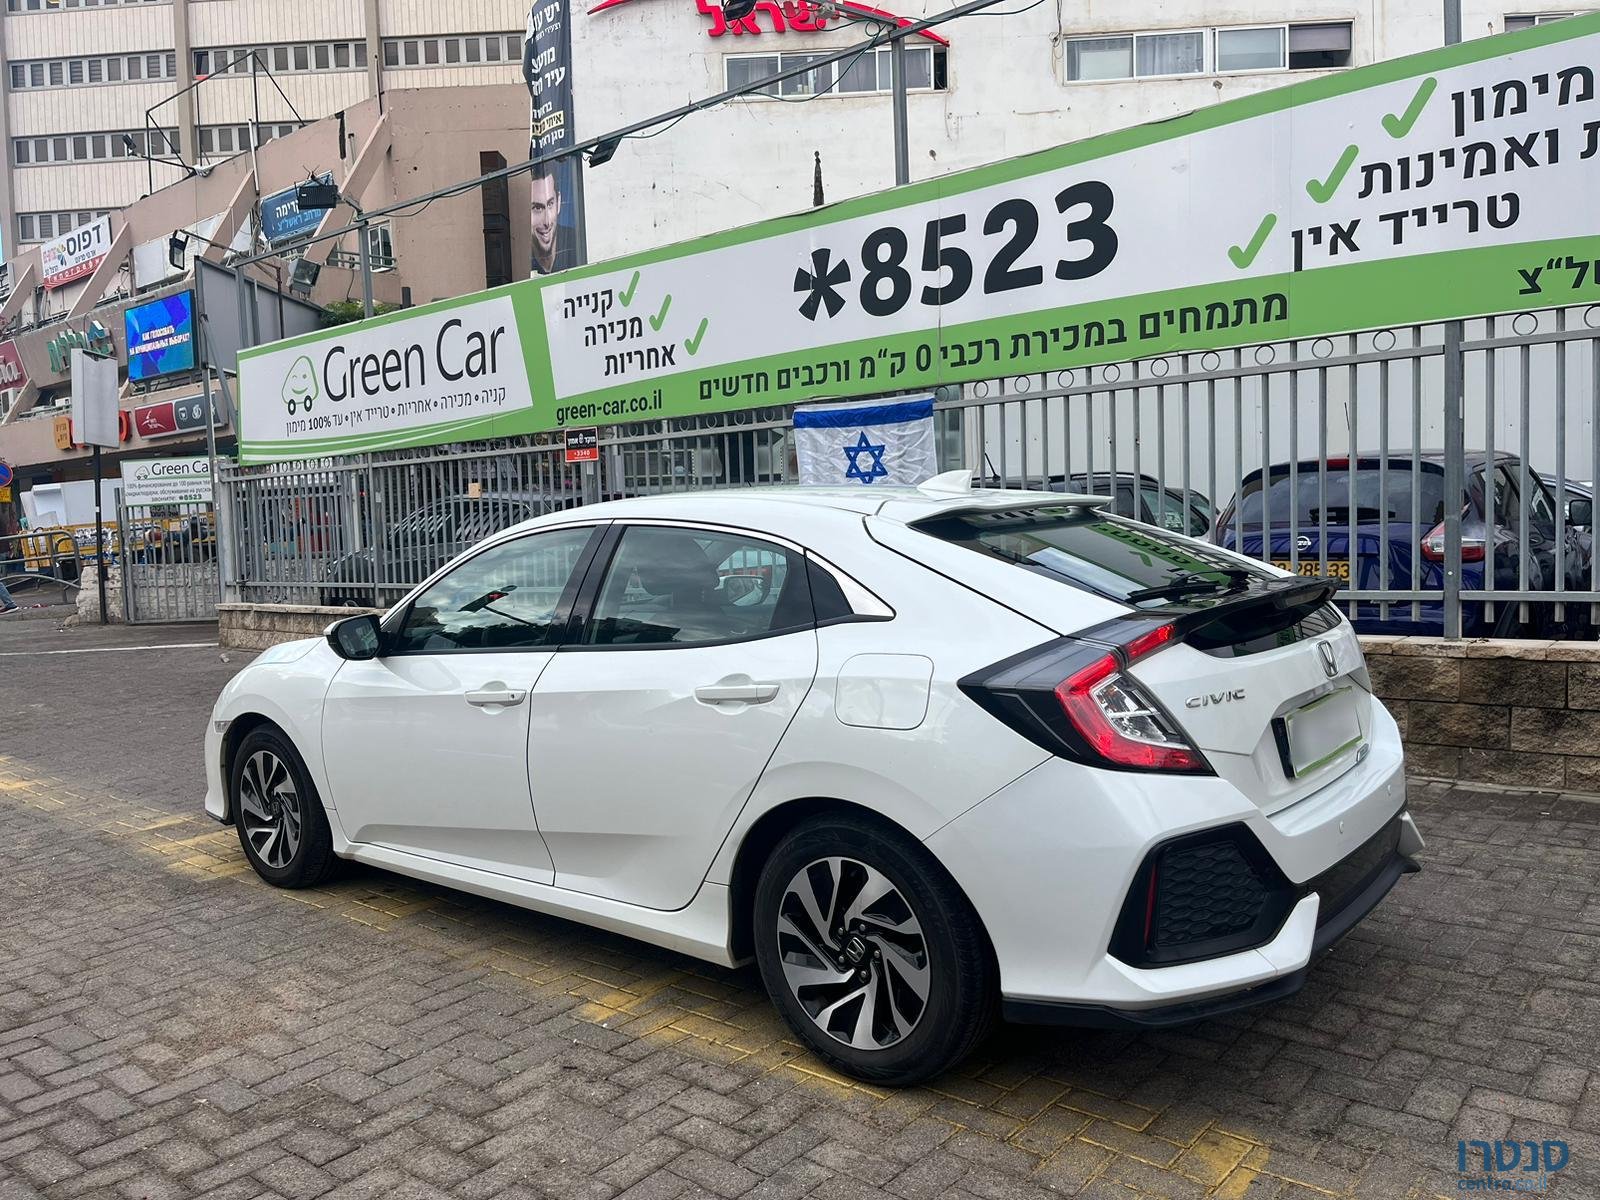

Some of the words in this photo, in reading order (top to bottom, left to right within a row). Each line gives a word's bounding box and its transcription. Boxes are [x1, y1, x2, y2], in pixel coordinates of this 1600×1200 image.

[544, 66, 566, 88] עיר
[1451, 65, 1595, 138] מימון
[1358, 127, 1559, 200] ואמינות
[1378, 192, 1521, 246] טרייד
[66, 224, 101, 256] דפוס
[1291, 218, 1361, 272] אין
[563, 288, 613, 319] קנייה
[1138, 292, 1289, 341] מתמחים
[585, 316, 643, 347] מכירה
[1009, 318, 1127, 360] במכירת
[323, 343, 426, 402] Green
[436, 318, 505, 382] Car
[604, 343, 676, 377] אחריות
[939, 337, 1000, 368] רכבי
[699, 371, 769, 400] חדשים
[776, 358, 850, 391] ורכבים
[397, 398, 432, 417] אחריות
[440, 391, 472, 411] מכירה
[481, 386, 506, 408] קניה
[556, 388, 663, 426] green-car.co.il
[286, 420, 307, 438] מימון
[308, 415, 332, 432] 100%
[332, 413, 343, 426] עד
[350, 408, 364, 428] אין
[365, 405, 390, 422] טרייד
[151, 462, 190, 476] Green
[1184, 688, 1247, 709] CIVIC
